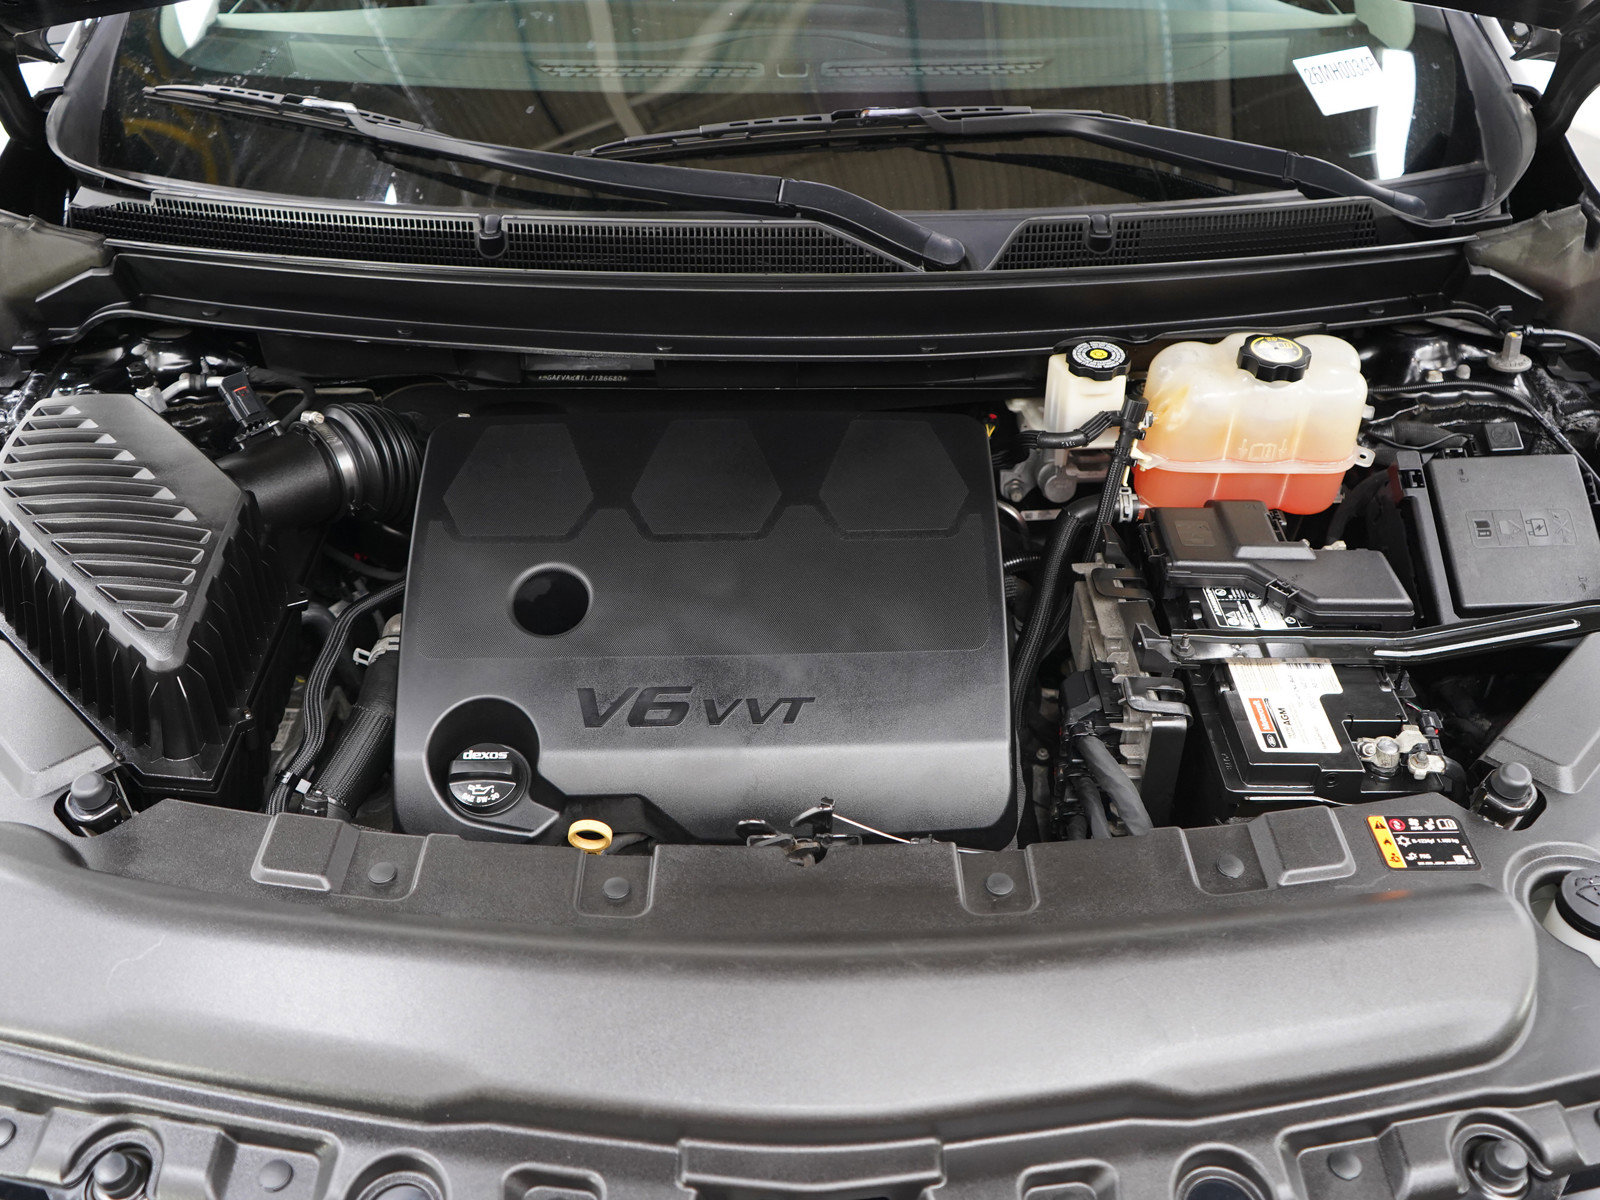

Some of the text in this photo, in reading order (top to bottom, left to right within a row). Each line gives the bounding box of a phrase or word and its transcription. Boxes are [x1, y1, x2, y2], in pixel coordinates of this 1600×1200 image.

[577, 686, 815, 728] V6 VVT
[1277, 707, 1292, 726] AGM
[462, 749, 510, 760] dexos
